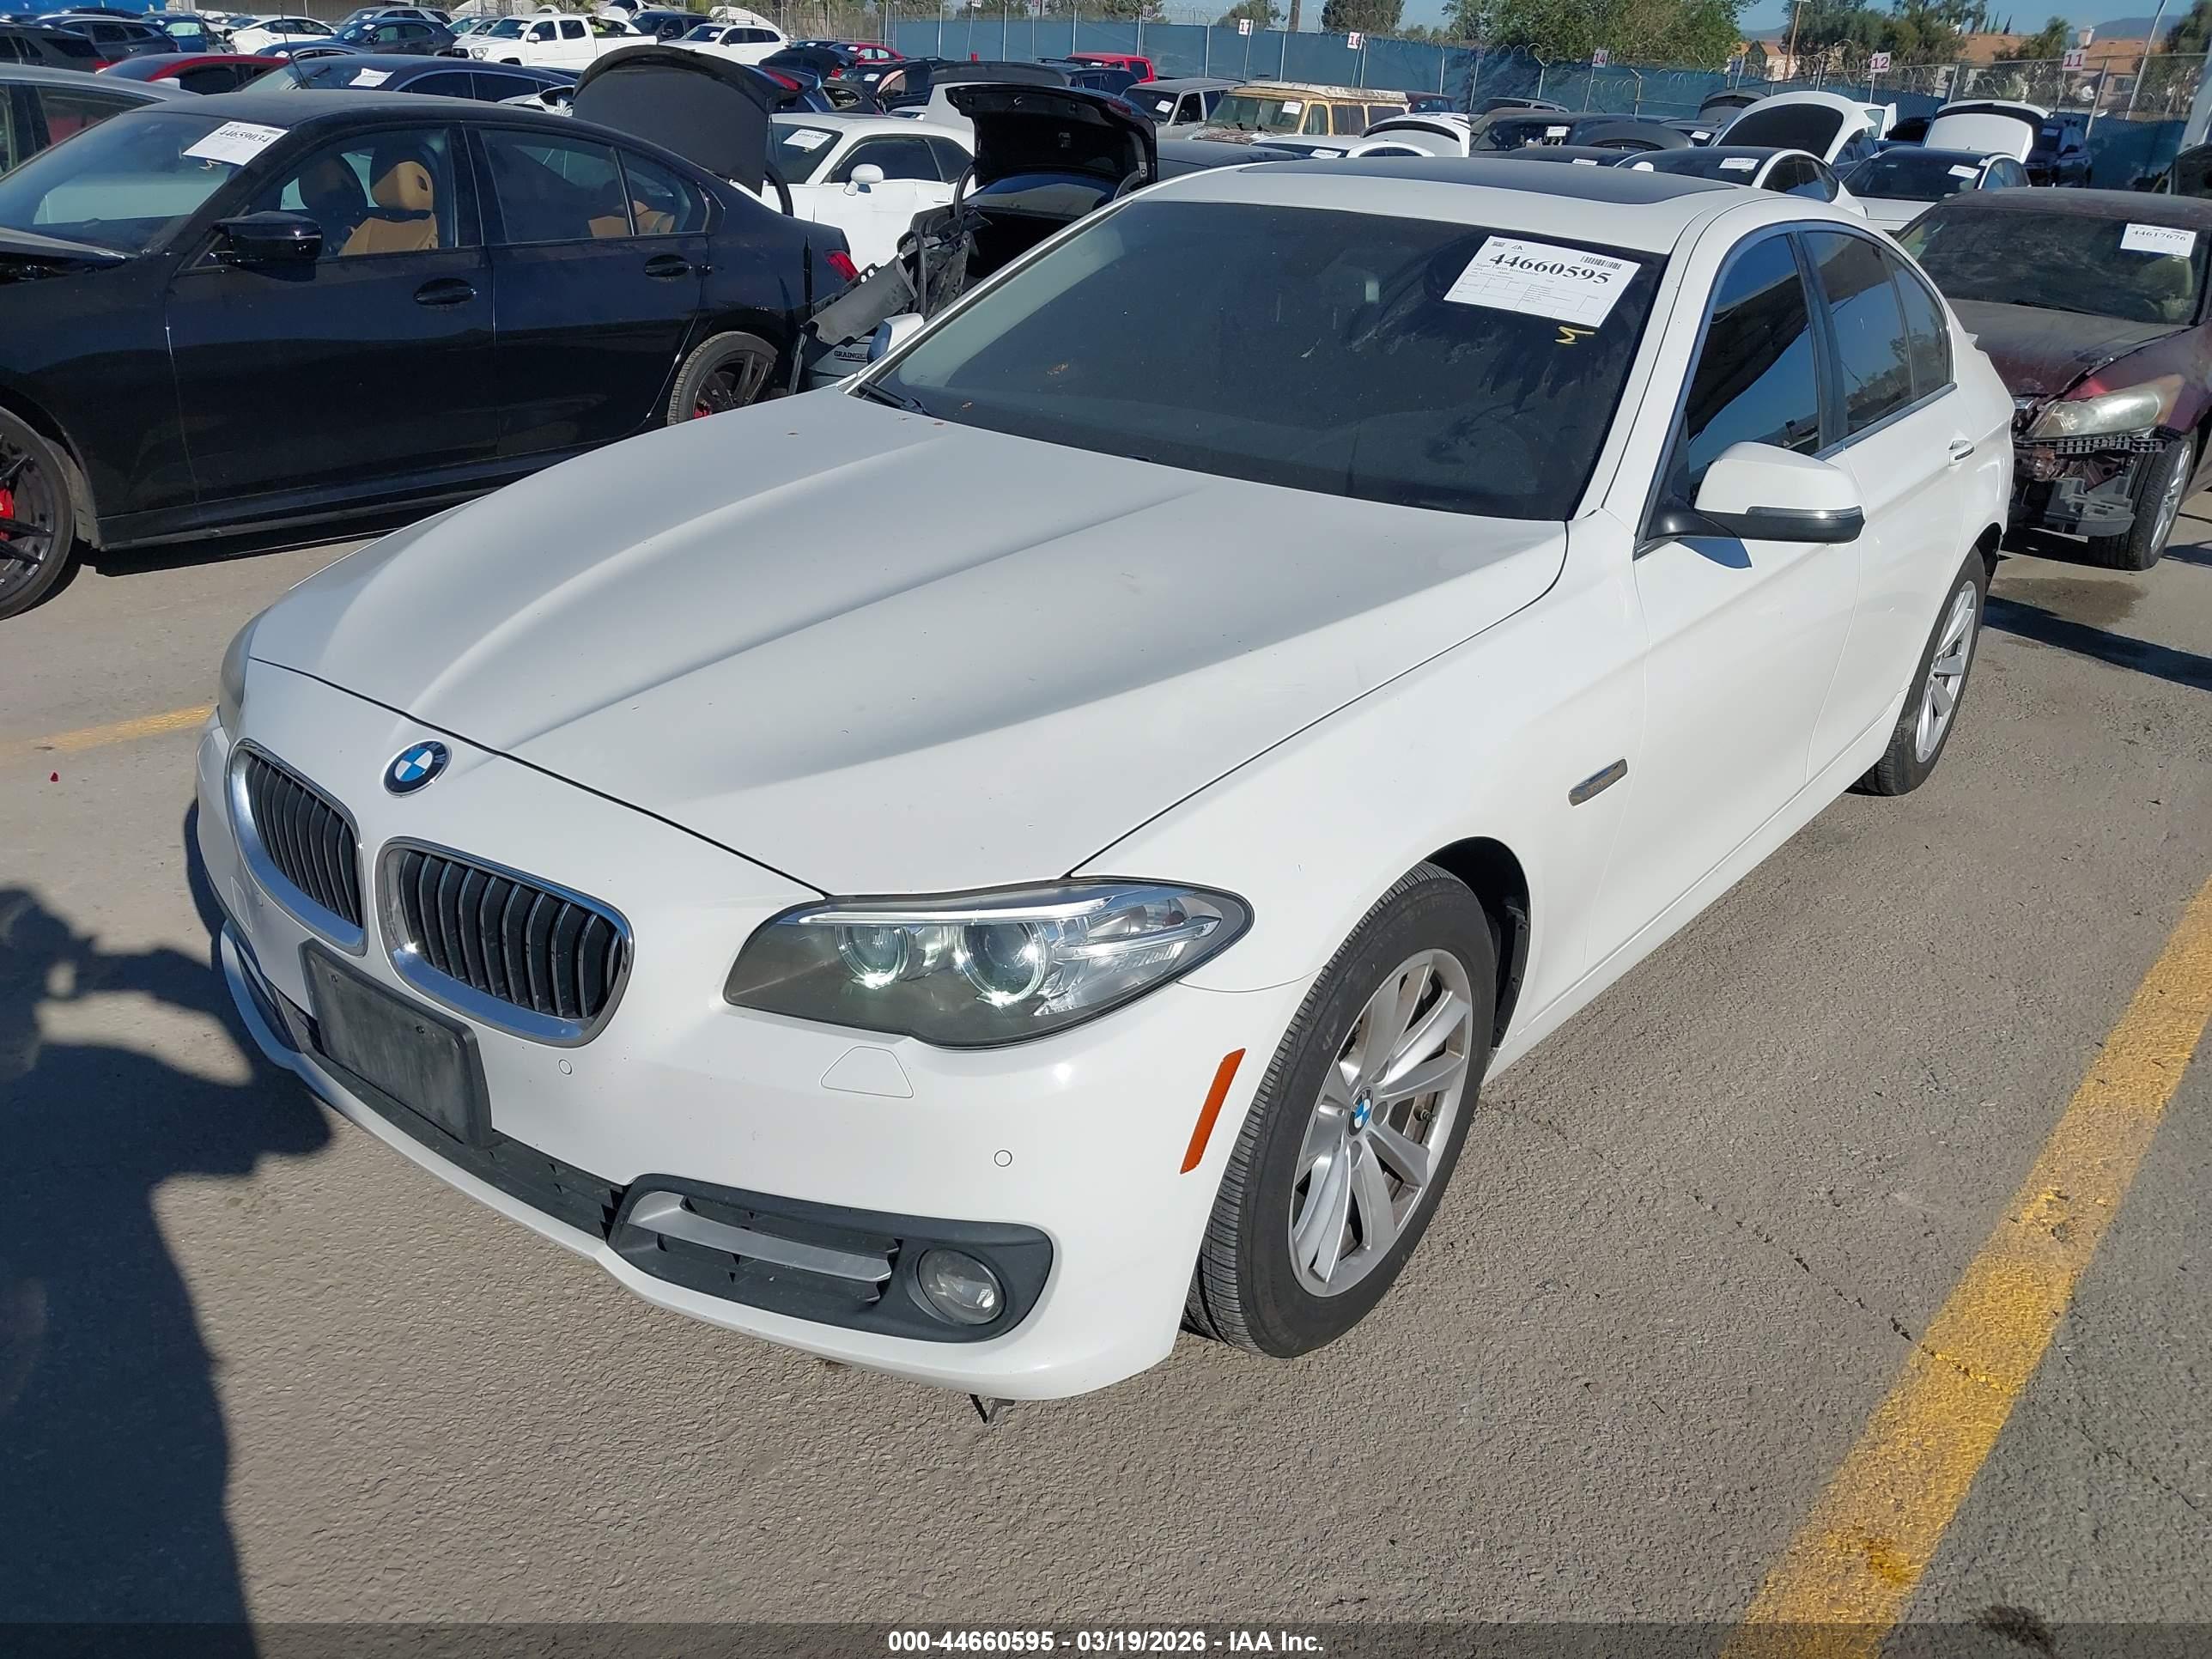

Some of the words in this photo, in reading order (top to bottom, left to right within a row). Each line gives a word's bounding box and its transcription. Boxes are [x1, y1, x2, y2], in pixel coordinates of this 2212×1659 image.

[1143, 8, 1152, 18] 18
[1593, 52, 1606, 64] 14
[1871, 56, 1889, 70] 12
[2063, 53, 2082, 67] 11
[2132, 230, 2186, 241] 44617676
[1489, 253, 1613, 284] 44660595
